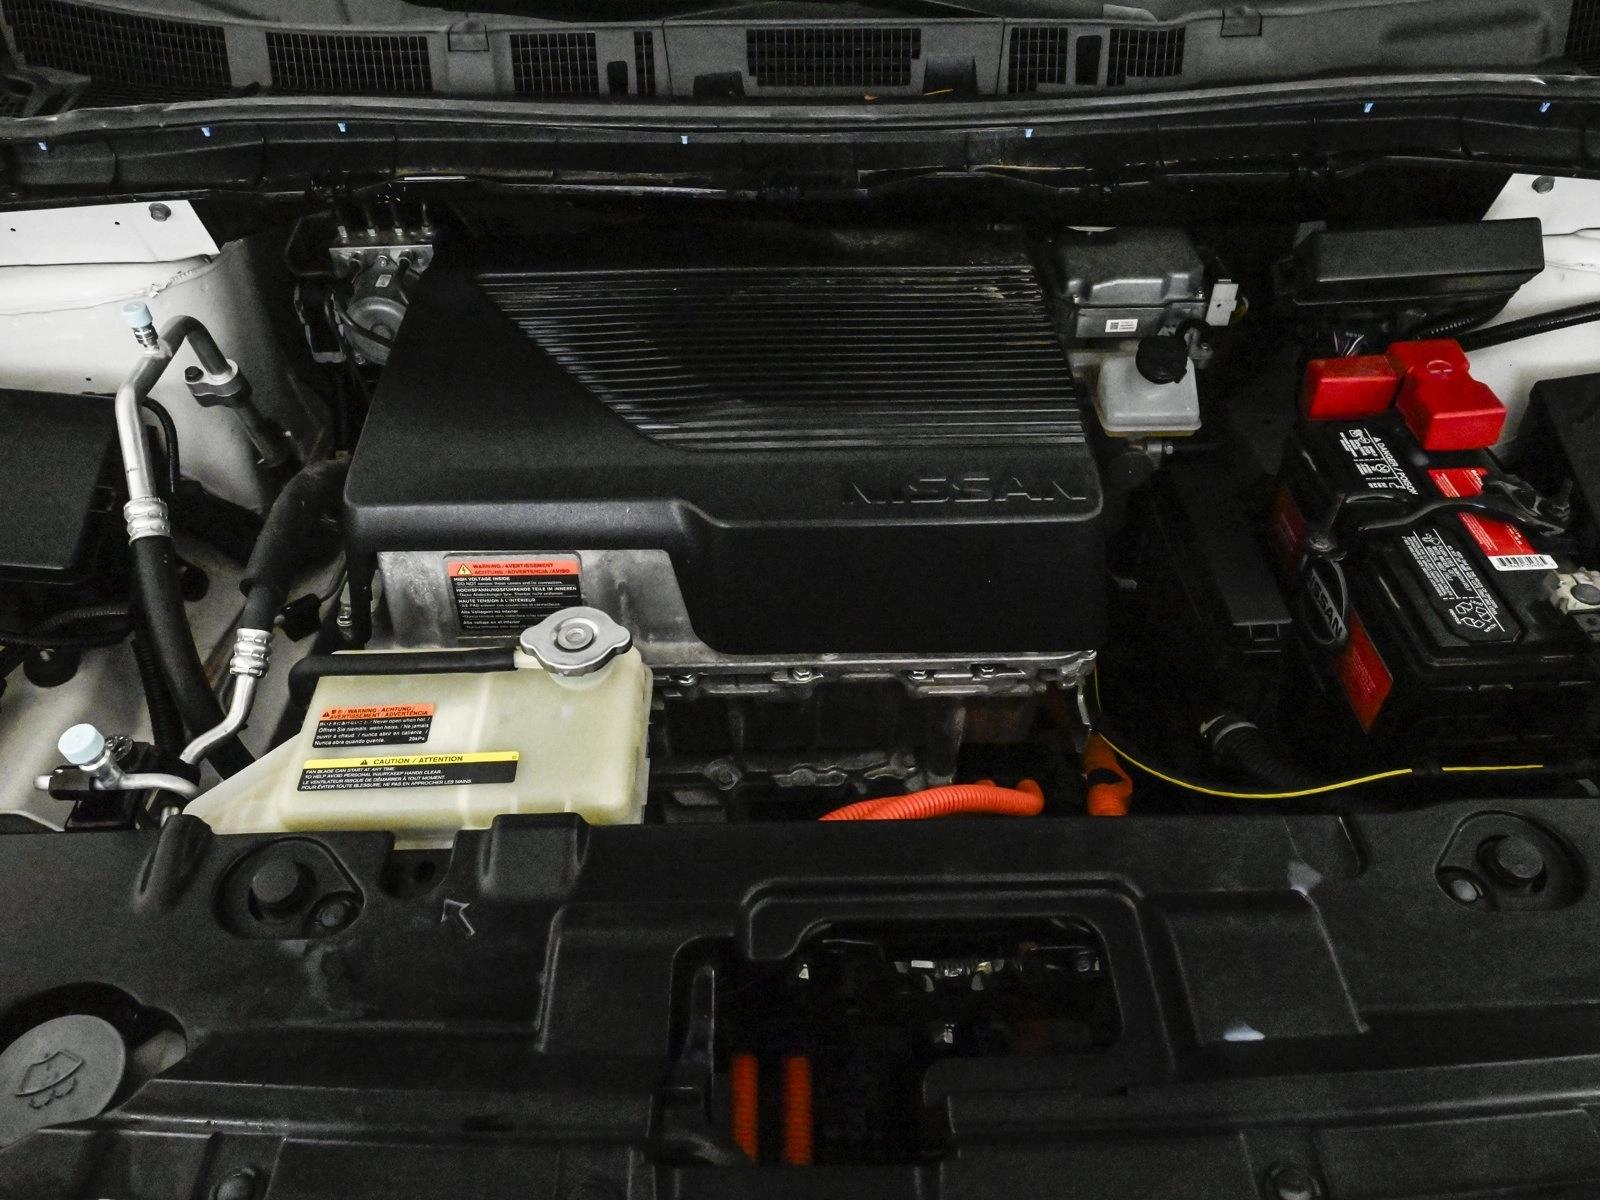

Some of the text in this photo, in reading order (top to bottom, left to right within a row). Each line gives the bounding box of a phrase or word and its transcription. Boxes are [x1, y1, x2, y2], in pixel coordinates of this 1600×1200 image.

[1377, 443, 1398, 467] DANGER
[1397, 472, 1419, 495] POISON
[842, 477, 1087, 504] NISSAN
[373, 757, 410, 765] CAUTION
[418, 755, 464, 764] ATTENTION
